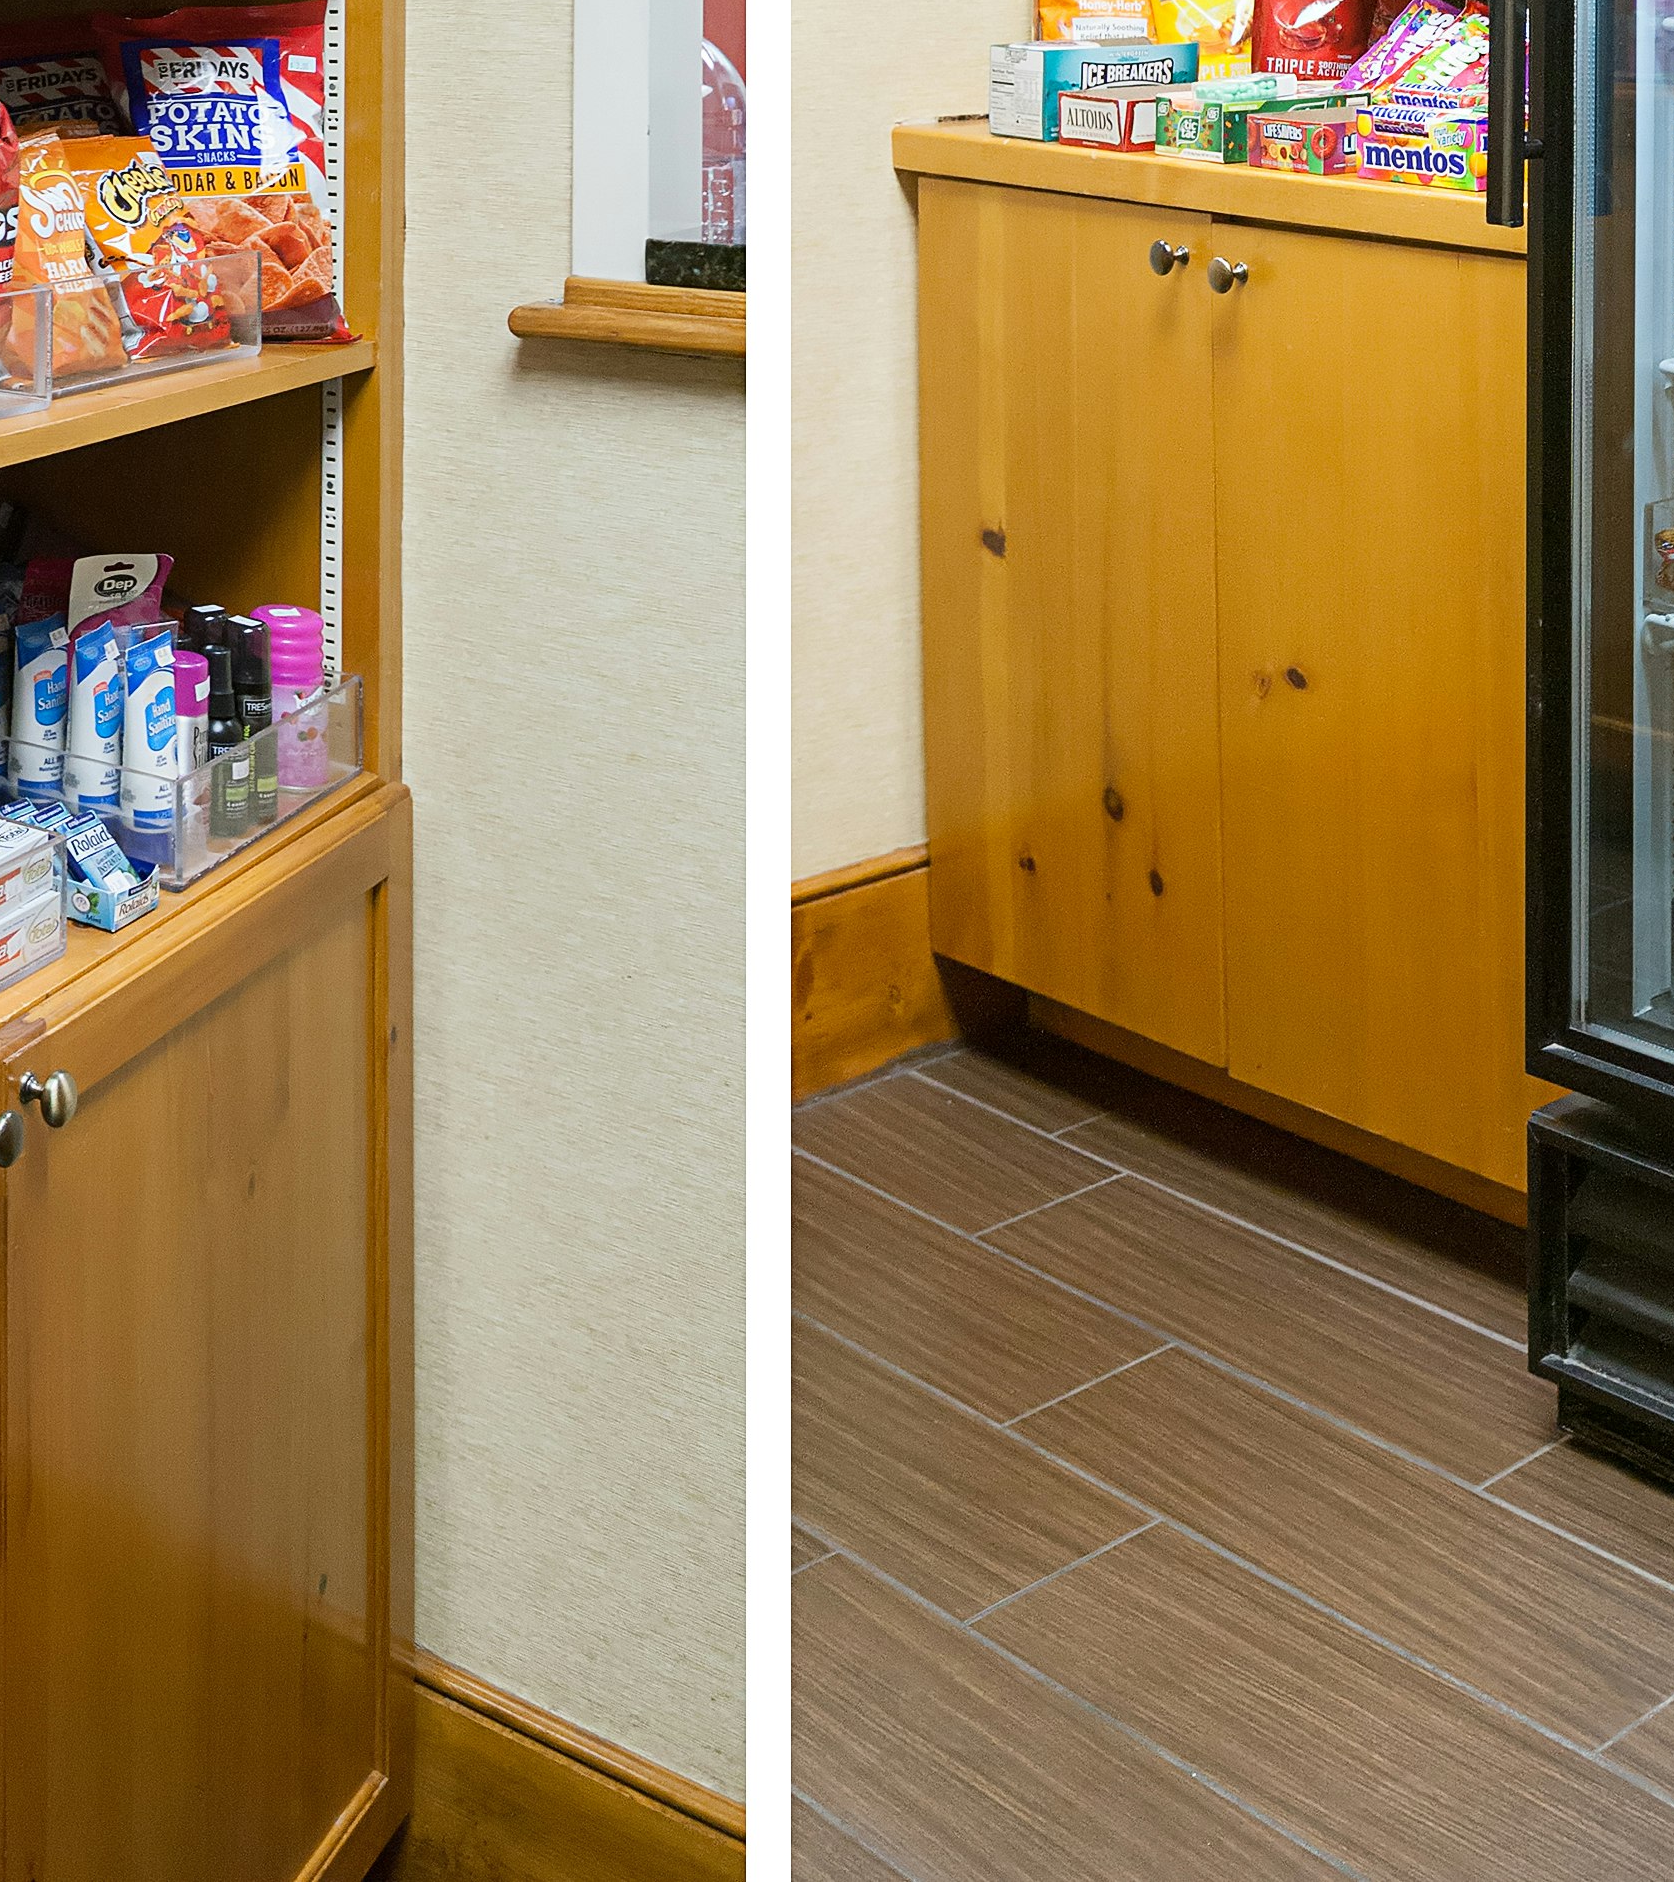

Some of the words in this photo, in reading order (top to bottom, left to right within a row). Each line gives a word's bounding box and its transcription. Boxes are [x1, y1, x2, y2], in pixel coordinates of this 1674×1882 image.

[1075, 22, 1110, 35] Naturally
[1112, 22, 1145, 36] Soothing
[168, 60, 250, 82] FRIDAYS
[1081, 62, 1105, 89] ICE
[1106, 58, 1174, 85] BREAKERS
[1266, 56, 1315, 76] TRIPLE
[16, 67, 98, 94] FRIDAYS
[147, 101, 273, 126] POTATO
[1066, 105, 1114, 131] ALTOIDS
[1182, 116, 1198, 130] tic
[150, 125, 275, 154] SKINS
[1179, 127, 1197, 141] tac
[1436, 131, 1466, 148] variety
[196, 150, 238, 164] SNACKS
[1365, 144, 1467, 176] mentos
[225, 172, 237, 189] &
[103, 576, 135, 593] Dep
[150, 698, 172, 715] Hand
